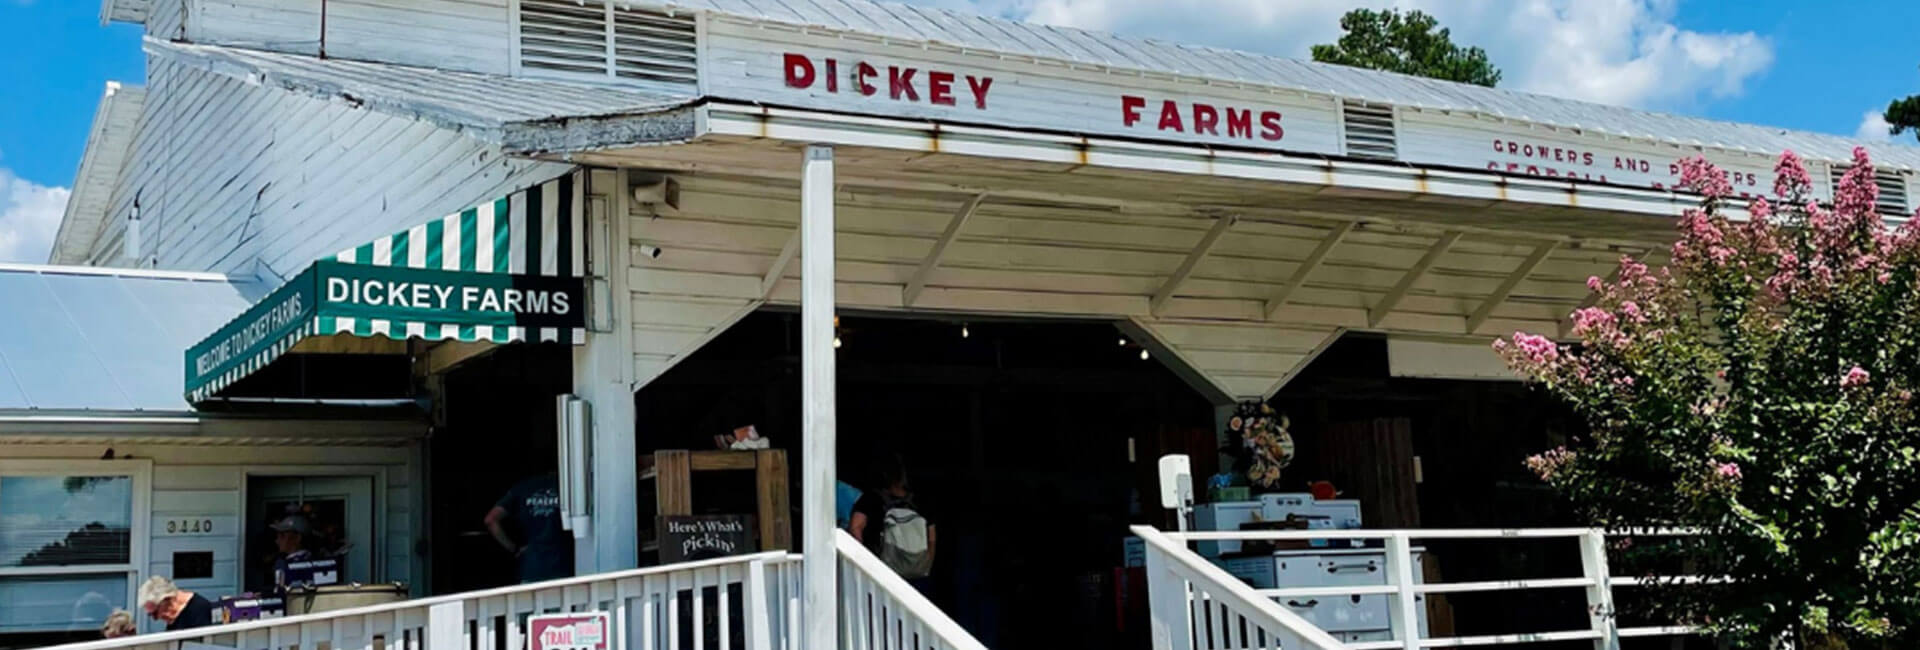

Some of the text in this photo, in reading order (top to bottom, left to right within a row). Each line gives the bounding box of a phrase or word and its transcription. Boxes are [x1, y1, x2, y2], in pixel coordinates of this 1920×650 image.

[783, 52, 1284, 141] DICKEY FARMS
[1493, 139, 1757, 187] GROWERS AND PERS
[326, 276, 571, 315] DICKEY FARMS
[196, 338, 231, 377] WELCOME
[242, 311, 271, 351] DICKEY
[271, 291, 302, 333] FARMS
[544, 630, 573, 646] TRAIL
